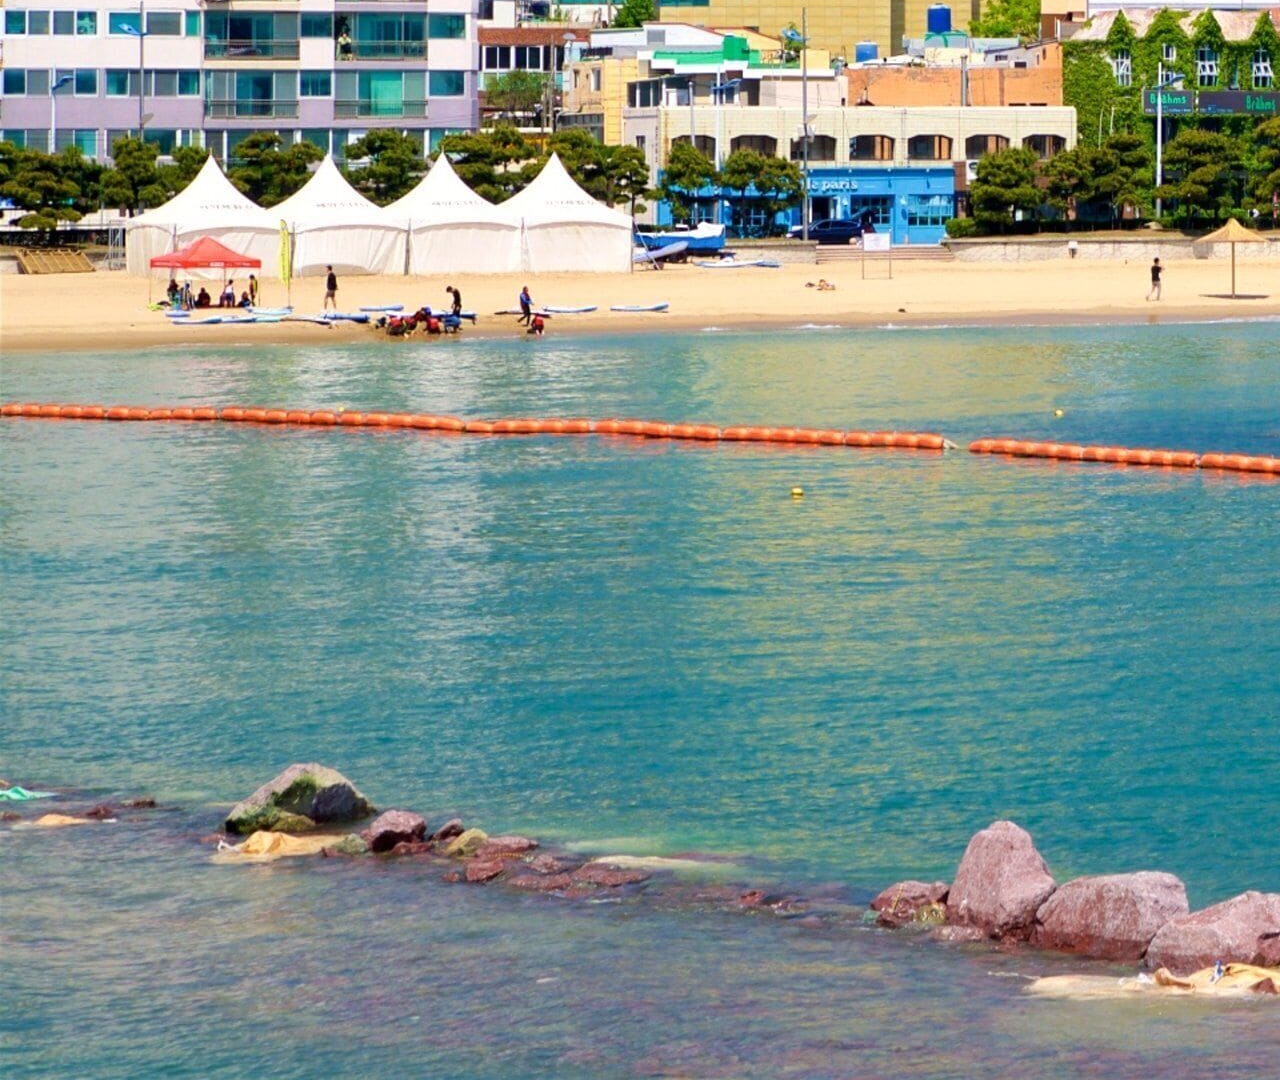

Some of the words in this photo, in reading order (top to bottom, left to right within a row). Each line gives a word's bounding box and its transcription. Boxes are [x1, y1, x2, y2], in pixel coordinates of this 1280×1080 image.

[1149, 92, 1188, 104] Bahms
[1246, 95, 1276, 111] Brahms
[821, 180, 858, 193] paris
